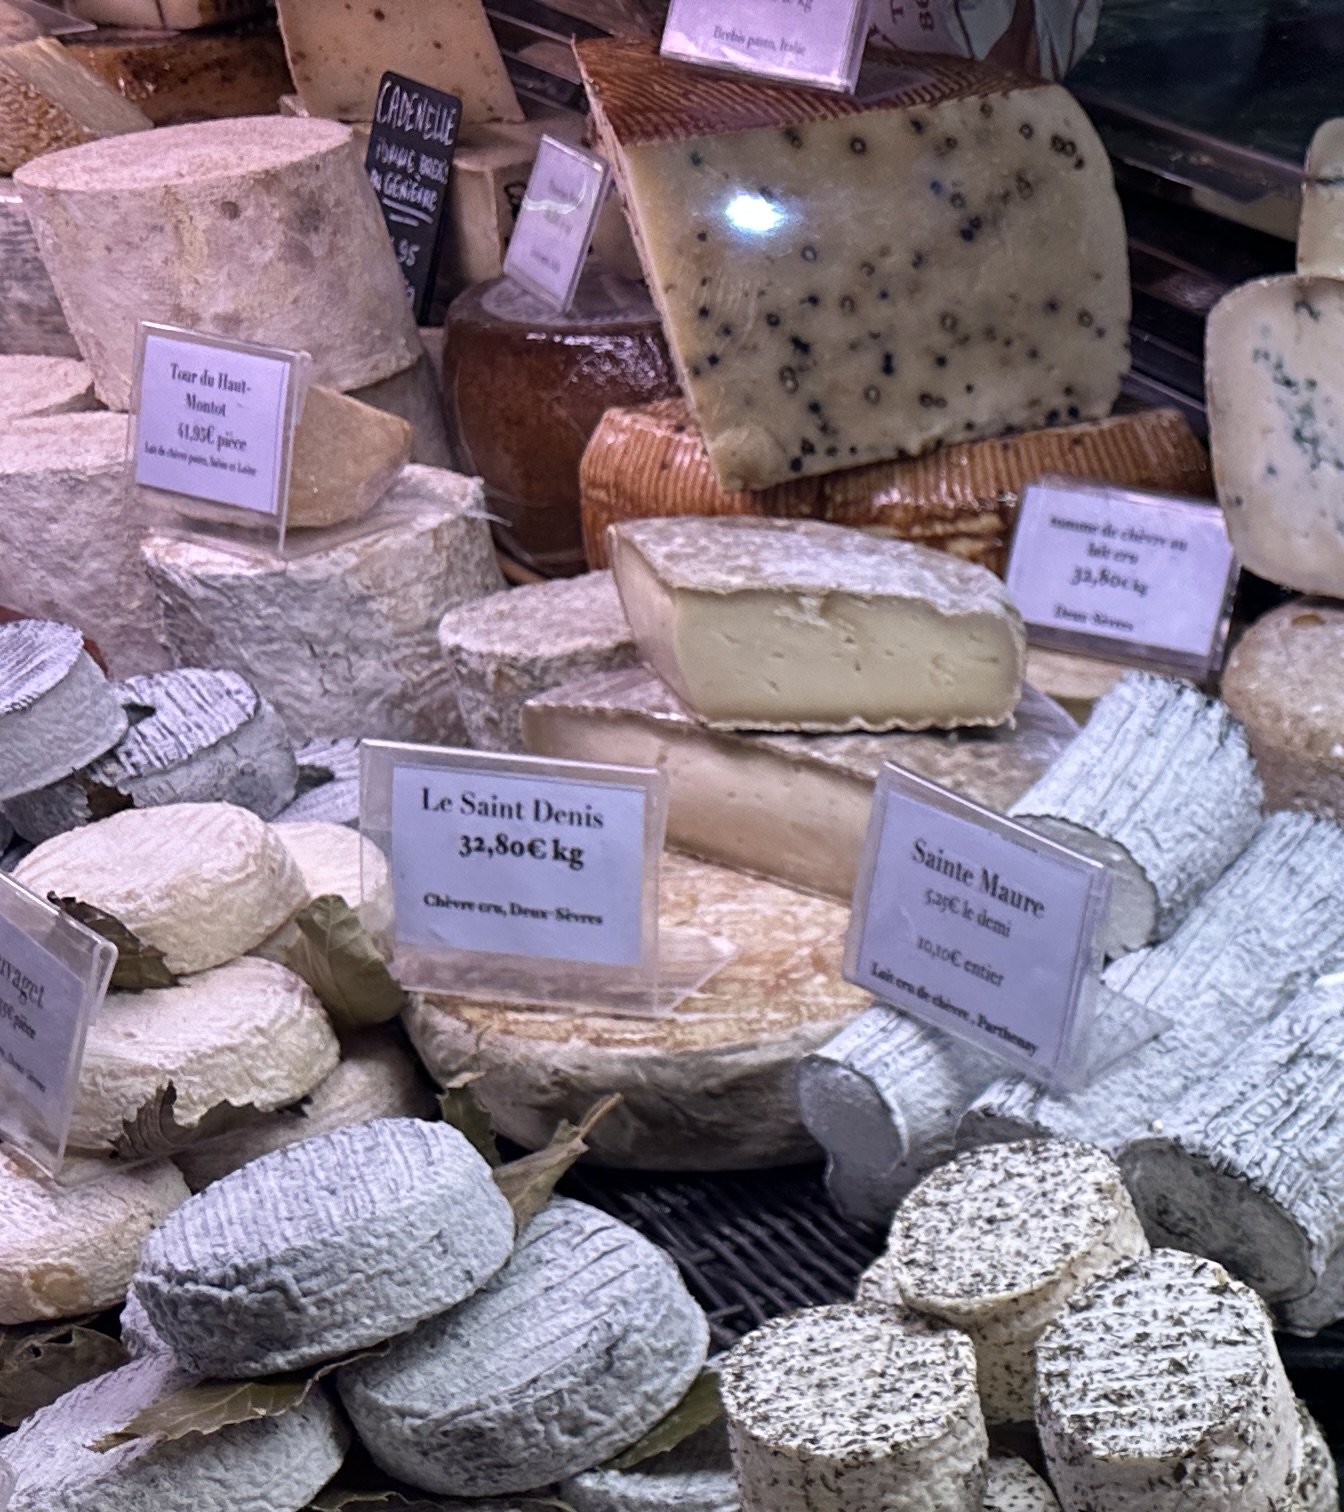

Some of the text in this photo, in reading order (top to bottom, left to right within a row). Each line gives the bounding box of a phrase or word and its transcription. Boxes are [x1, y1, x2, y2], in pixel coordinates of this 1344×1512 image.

[171, 363, 198, 384] Tour
[200, 369, 214, 388] du
[421, 786, 604, 828] Le Saint Denis
[458, 832, 585, 871] 32,80€ kg
[912, 836, 1045, 919] Sainte Maure
